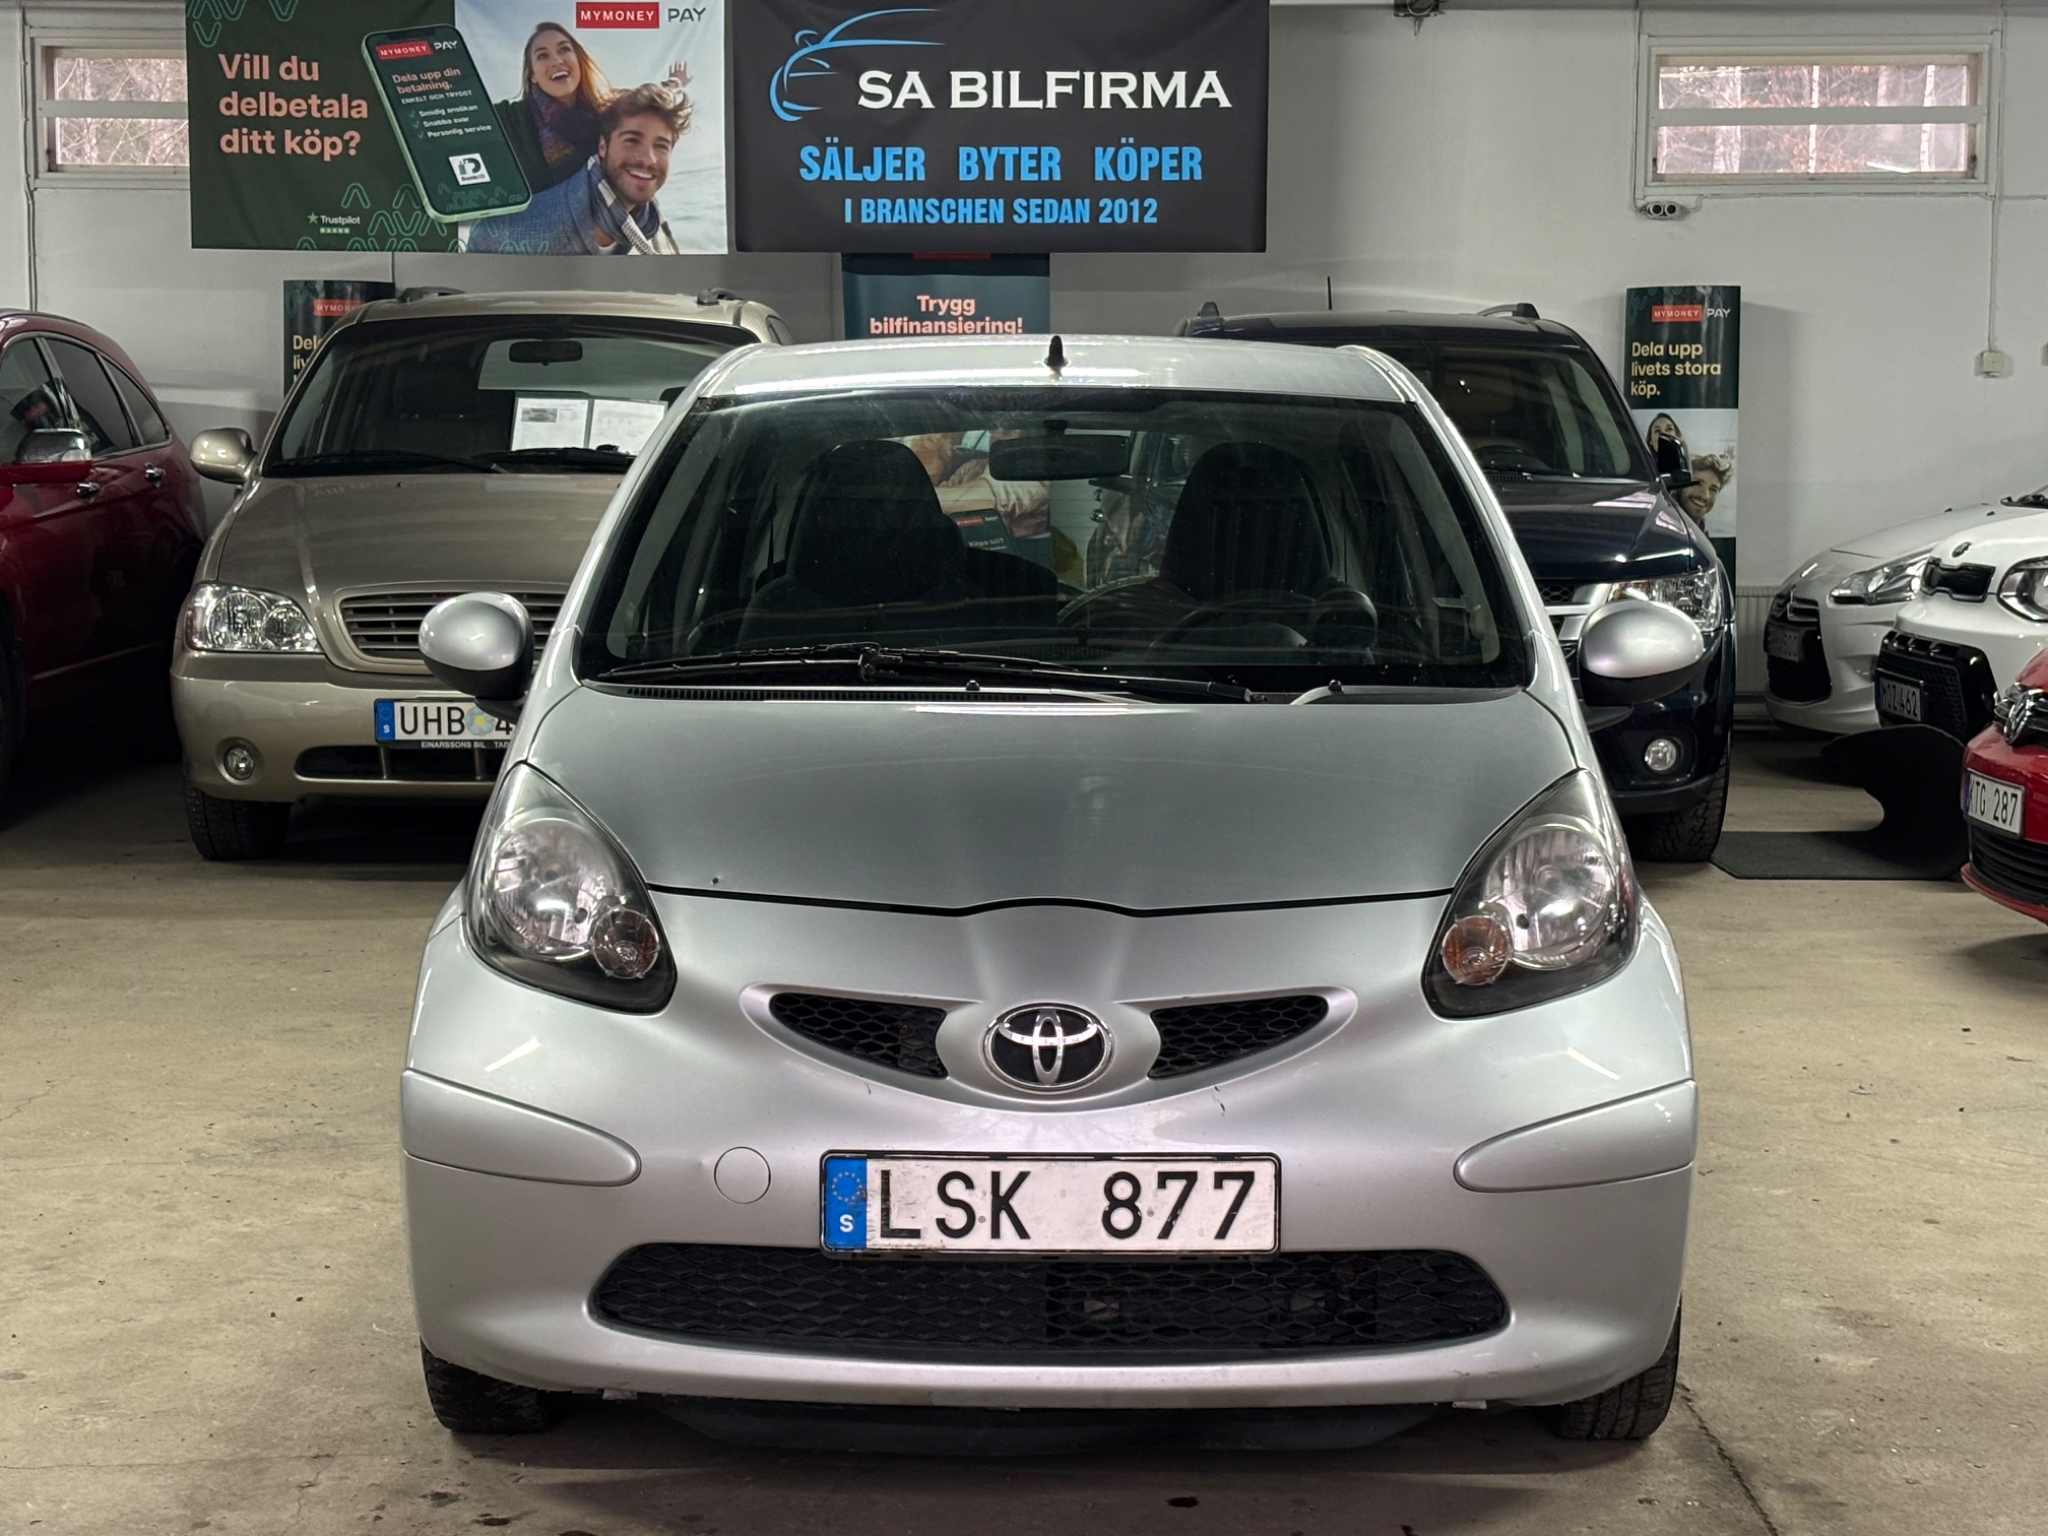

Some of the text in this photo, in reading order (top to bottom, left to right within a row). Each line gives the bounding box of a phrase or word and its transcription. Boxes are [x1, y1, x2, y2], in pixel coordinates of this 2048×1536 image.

[580, 7, 706, 23] MYMONEY PAY
[380, 40, 458, 56] MYMONEY PAY
[218, 53, 320, 81] Vill du
[392, 67, 461, 83] Dela upp din
[857, 70, 1233, 110] SA BILFIRMA
[219, 92, 368, 118] delbetala
[219, 128, 361, 162] ditt köp?
[799, 136, 1203, 181] SÄLJER BYTER KÖPER
[320, 215, 361, 226] Trustpilot
[845, 198, 1158, 225] I BRANSCHEN SEDAN 2012
[916, 295, 976, 316] Trygg
[1654, 308, 1731, 319] MYMONEY PAY
[870, 316, 1023, 335] bilfinansiering!
[1631, 341, 1703, 360] Dela upp
[1631, 361, 1722, 376] livets stora
[1630, 381, 1661, 399] köp.
[400, 706, 465, 736] UHB
[421, 741, 472, 749] EINARSSONS
[473, 741, 486, 749] BIL
[1993, 787, 2018, 827] 287
[840, 1170, 1256, 1239] S LSK 877
